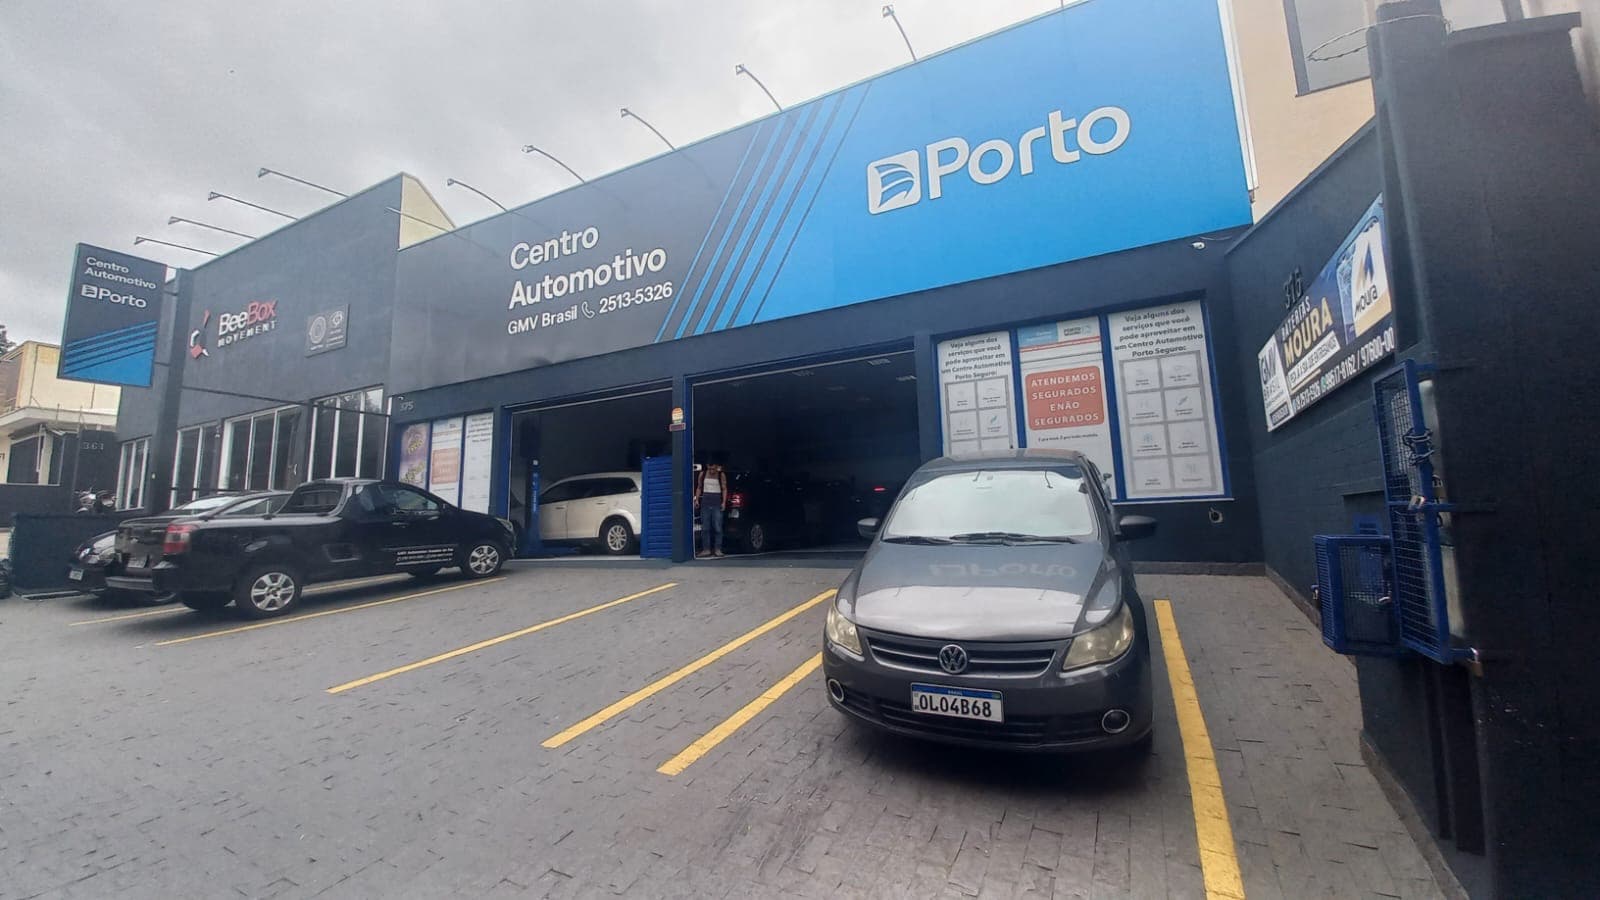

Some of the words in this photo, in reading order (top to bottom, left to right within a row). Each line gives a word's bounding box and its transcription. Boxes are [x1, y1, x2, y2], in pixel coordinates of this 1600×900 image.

[926, 106, 1131, 200] Porto
[510, 226, 599, 270] Centro
[86, 256, 129, 273] Centro
[84, 267, 156, 289] Automotivo
[508, 248, 667, 310] Automotivo
[98, 287, 147, 308] Porto
[507, 315, 538, 335] GMV
[541, 305, 578, 328] Brasil
[599, 281, 673, 314] 2513-5326
[1124, 314, 1141, 322] Veja
[1143, 310, 1169, 320] alguns
[1170, 308, 1185, 316] dos
[219, 298, 278, 336] BeeBox
[1119, 333, 1139, 342] pode
[1140, 327, 1181, 338] aproveitar
[1122, 322, 1153, 332] serviços
[1154, 320, 1170, 328] que
[1284, 297, 1333, 368] MOURA
[1127, 339, 1154, 349] Centro
[1155, 333, 1203, 345] Automotivo
[1131, 348, 1154, 357] Porto
[1154, 345, 1186, 355] Seguro:
[1031, 372, 1096, 388] ATENDEMOS
[1032, 385, 1097, 400] SEGURADOS
[1034, 413, 1099, 426] SEGURADOS
